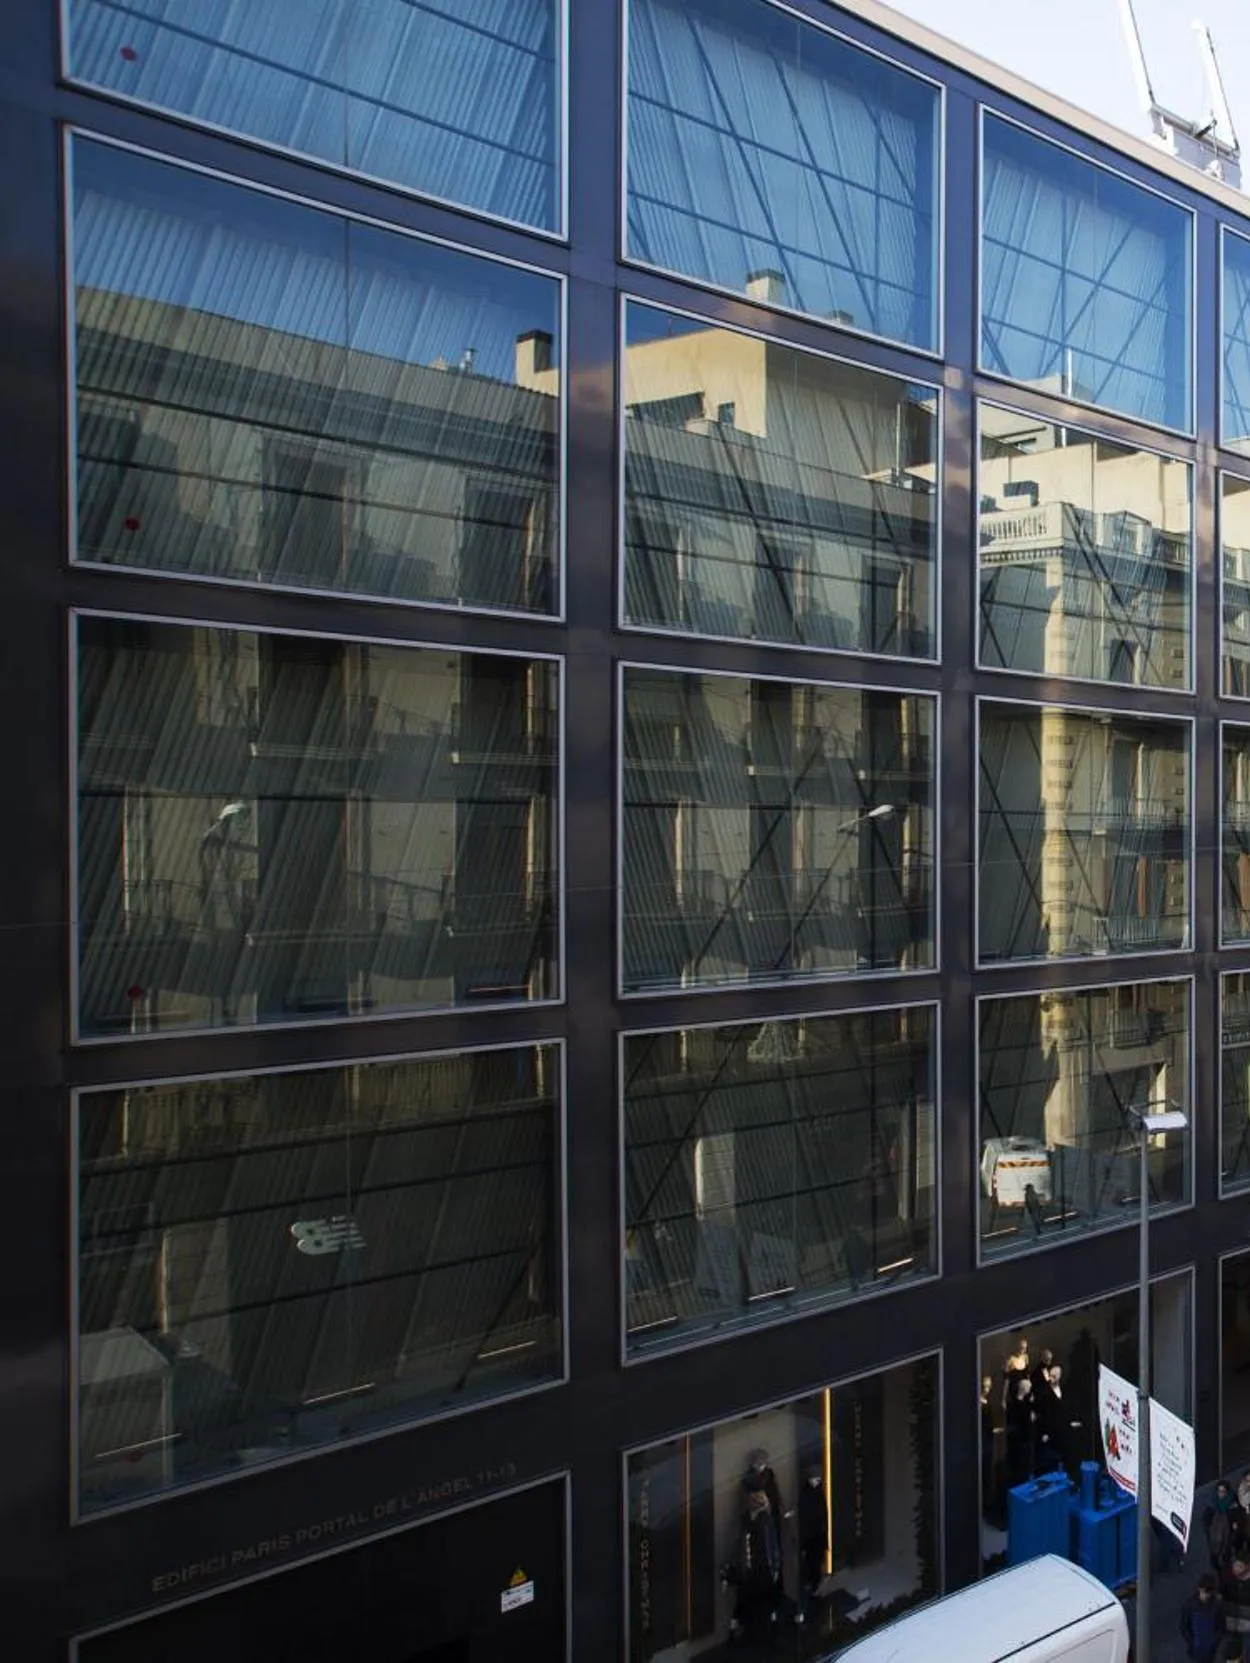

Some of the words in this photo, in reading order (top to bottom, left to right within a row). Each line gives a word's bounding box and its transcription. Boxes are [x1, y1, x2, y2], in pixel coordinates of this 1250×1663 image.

[152, 1556, 227, 1593] EDIFICI
[232, 1534, 293, 1567] PARIS
[296, 1511, 370, 1545] PORTAL
[373, 1497, 397, 1519] DE
